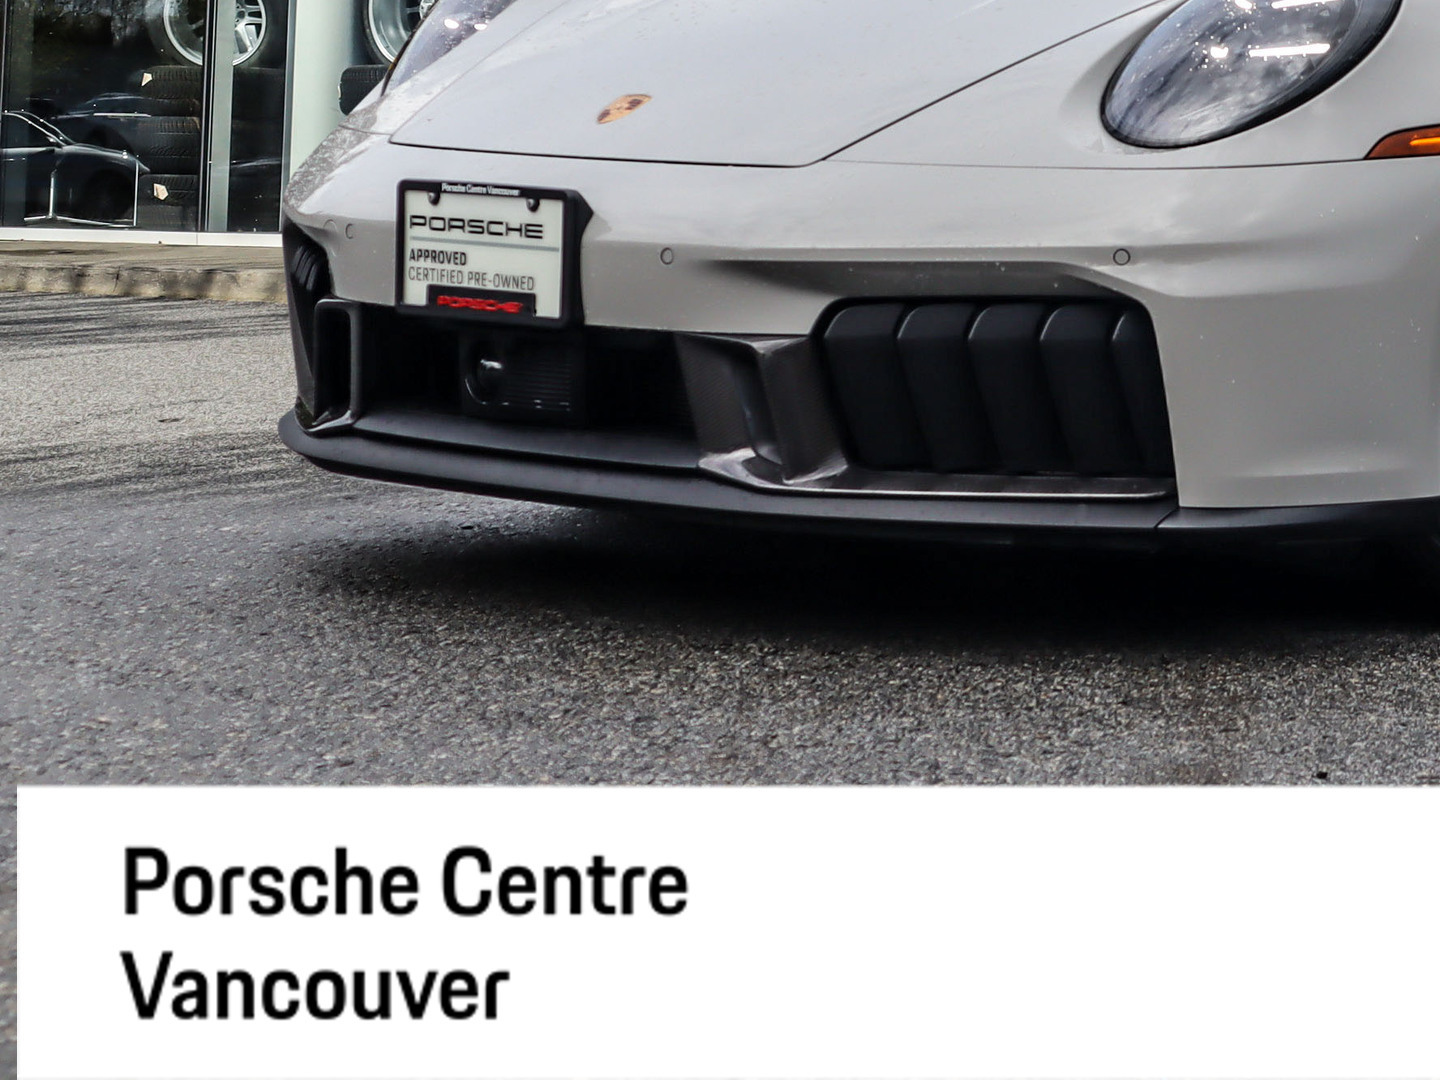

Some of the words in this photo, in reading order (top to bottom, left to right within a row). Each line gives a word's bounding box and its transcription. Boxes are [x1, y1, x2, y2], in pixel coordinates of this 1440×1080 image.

[441, 182, 466, 192] Porsche
[466, 184, 487, 194] Centre
[487, 185, 520, 196] Vancouver
[409, 215, 543, 239] PORSCHE
[409, 248, 467, 266] APPROVED
[408, 266, 464, 285] CERTIFIED
[467, 271, 534, 291] PRE-OWNED
